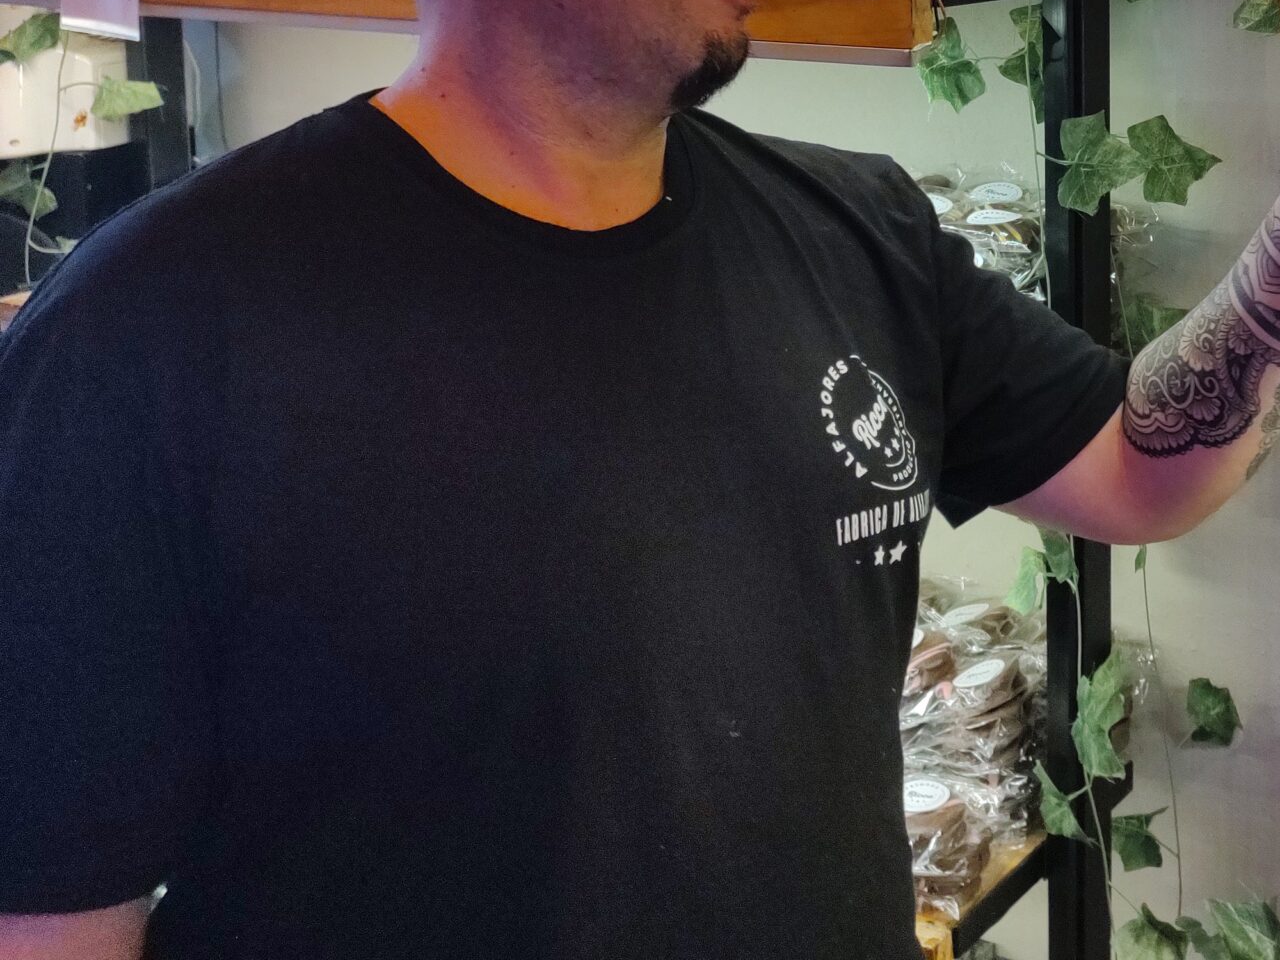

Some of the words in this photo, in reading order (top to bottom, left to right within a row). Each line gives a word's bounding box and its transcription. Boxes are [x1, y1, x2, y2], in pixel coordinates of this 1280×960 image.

[820, 360, 868, 479] ALFAJORES
[836, 504, 888, 546] FABRICA
[893, 499, 905, 528] DE
